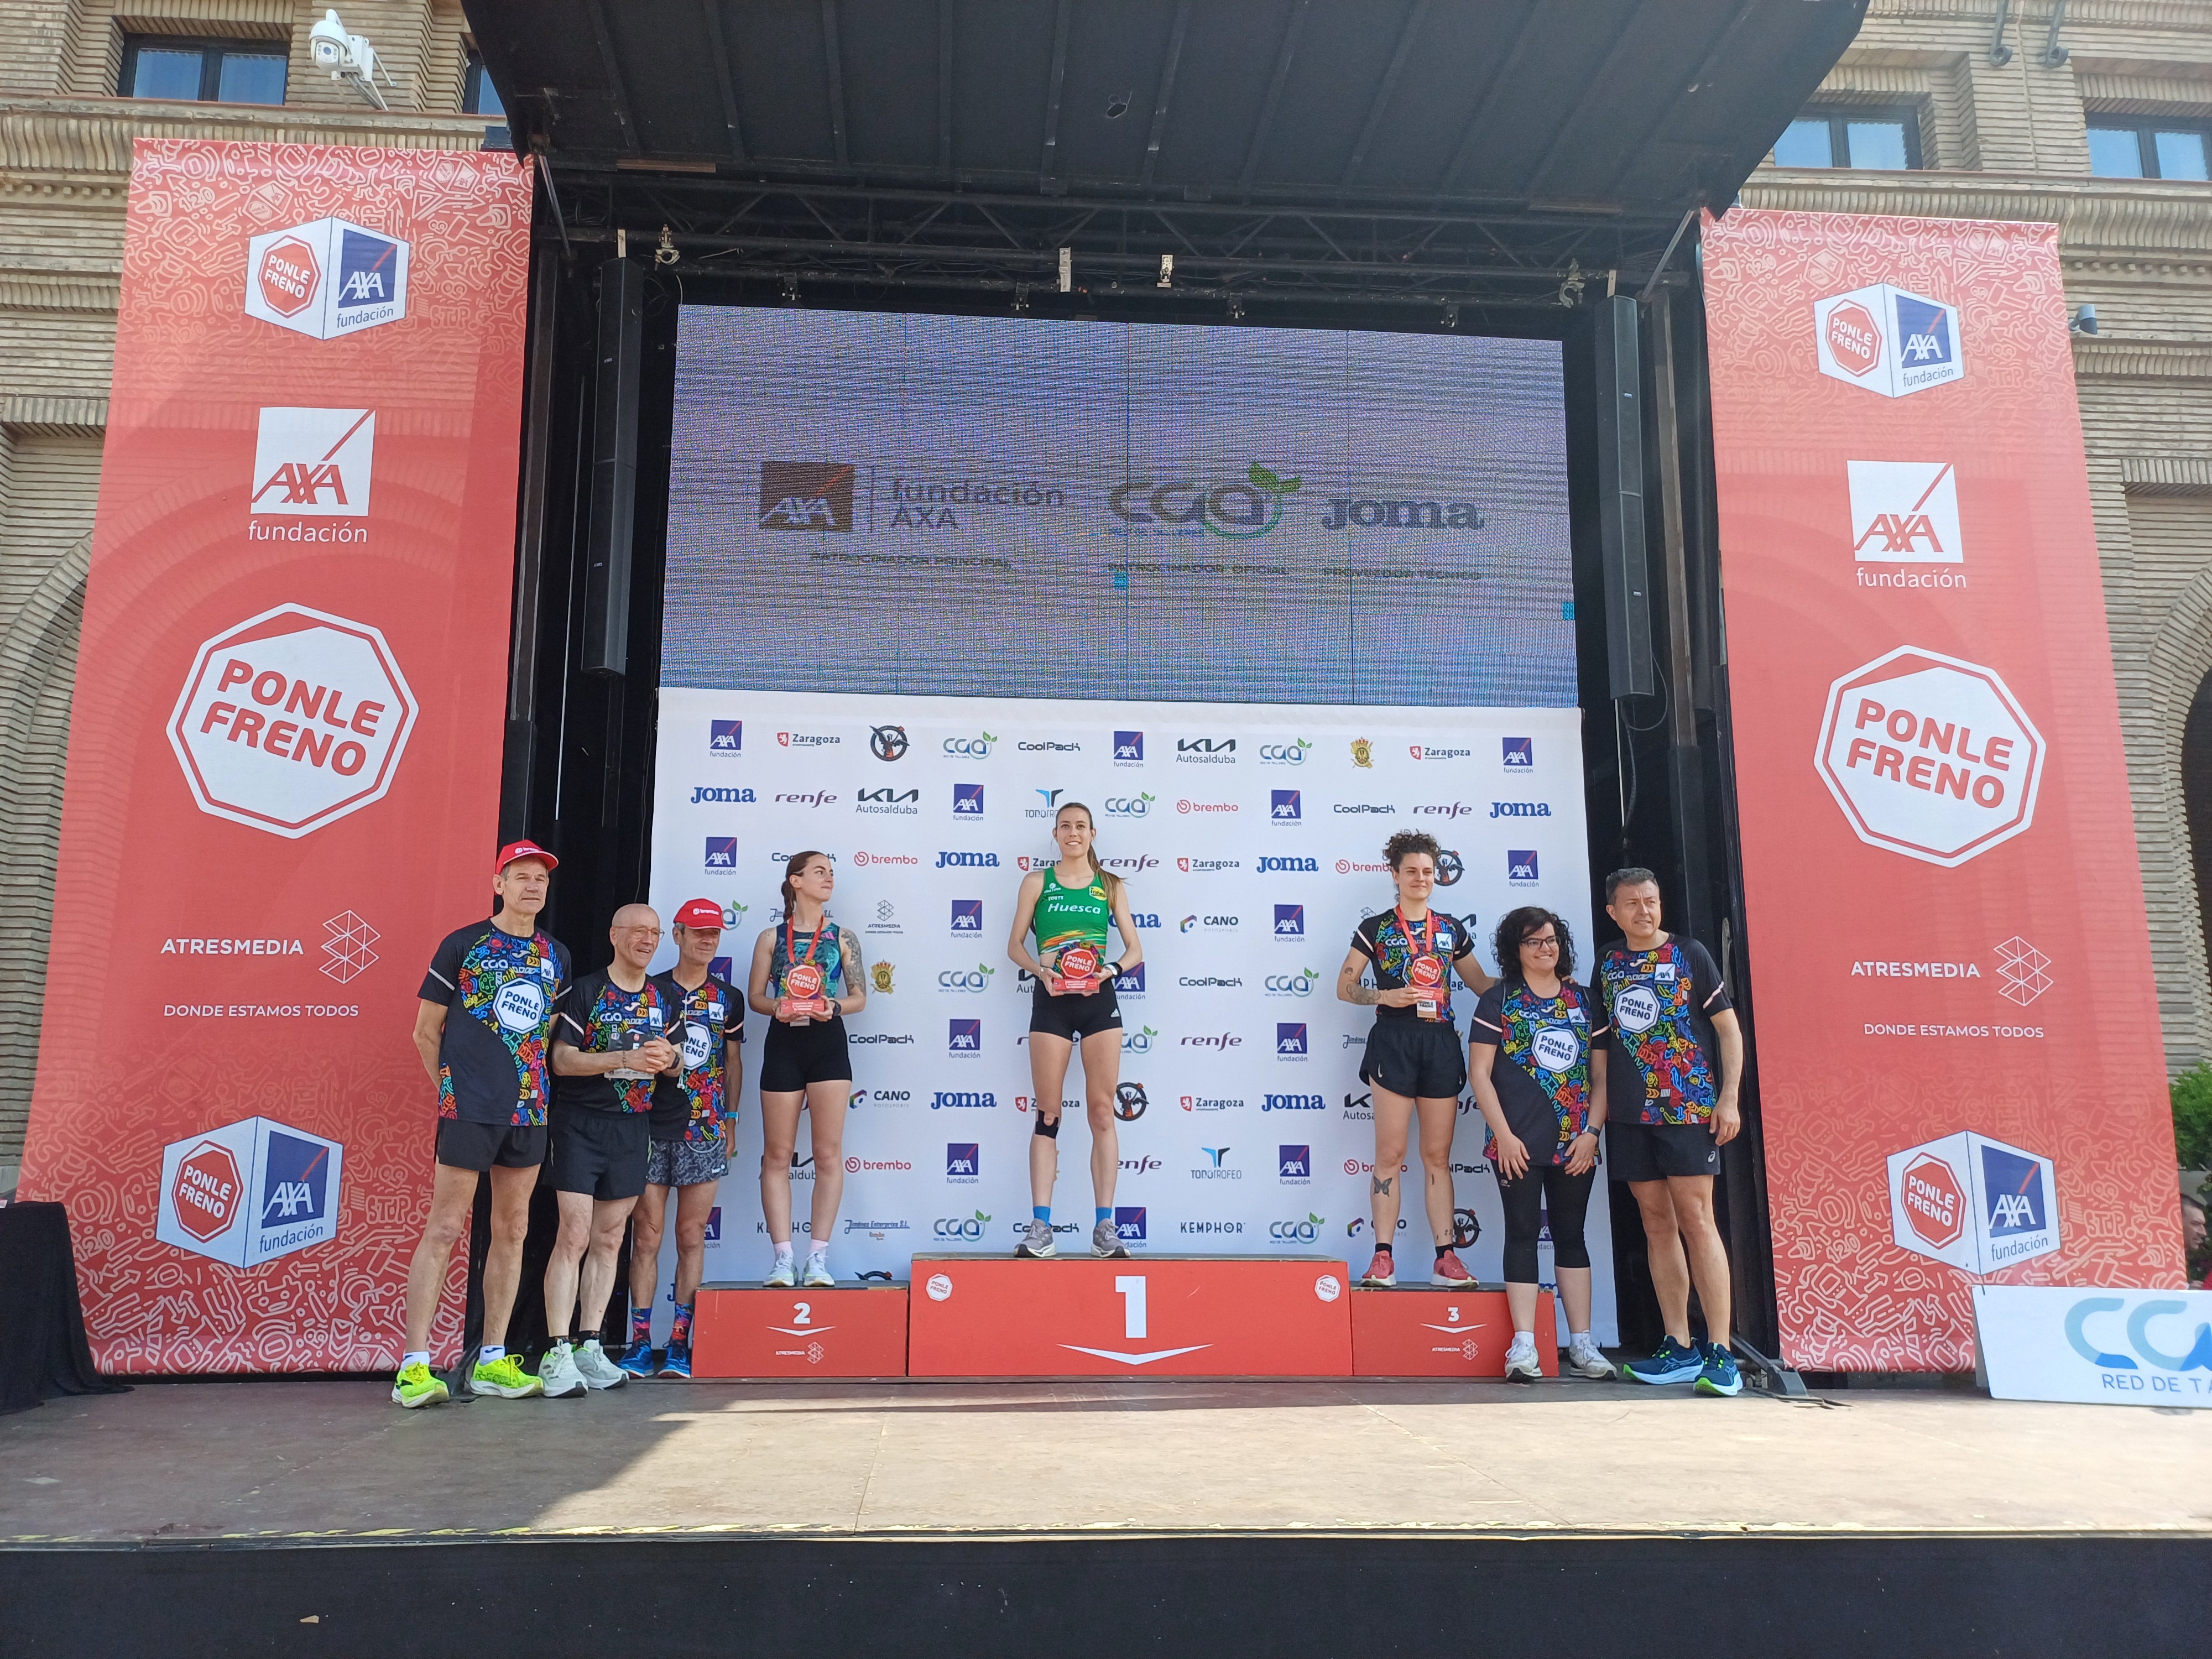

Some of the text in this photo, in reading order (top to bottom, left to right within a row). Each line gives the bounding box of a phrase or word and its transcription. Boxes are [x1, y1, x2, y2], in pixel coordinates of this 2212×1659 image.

[268, 254, 310, 283] PONLE
[265, 270, 306, 299] FRENO
[339, 270, 384, 300] AXA
[336, 306, 394, 328] fundación
[1833, 317, 1872, 346] PONLE
[1831, 333, 1870, 359] FRENO
[1901, 334, 1943, 362] AXA
[1903, 367, 1954, 387] fundación
[253, 463, 348, 505] AXA
[893, 479, 1063, 506] fundación
[758, 496, 836, 525] AXA
[891, 508, 958, 529] AXA
[248, 521, 368, 543] fundación
[1854, 514, 1944, 552] AXA
[1856, 568, 1966, 588] fundación
[217, 659, 385, 737] PONLE
[200, 702, 366, 775] FRENO
[792, 734, 839, 745] Zaragoza
[1855, 698, 2013, 771] PONLE
[711, 735, 736, 750] AXA
[1018, 742, 1080, 751] CoolPack
[1114, 745, 1138, 759] AXA
[1176, 754, 1235, 763] Autosalduba
[1425, 748, 1470, 759] Zaragoza
[1503, 751, 1527, 764] AXA
[1846, 738, 2004, 808] FRENO
[775, 790, 837, 808] renfe
[953, 799, 978, 813] AXA
[855, 805, 917, 814] Autosalduba
[1193, 802, 1238, 812] brembo
[1271, 804, 1296, 817] AXA
[1334, 805, 1395, 813] CoolPack
[1413, 801, 1472, 820] renfe
[706, 852, 730, 867] AXA
[872, 854, 917, 864] brembo
[1099, 854, 1159, 872] renfe
[1193, 859, 1239, 871] Zaragoza
[1353, 862, 1391, 872] bremb
[1509, 865, 1532, 878] AXA
[1048, 902, 1100, 914] Huesca
[951, 915, 976, 928] AXA
[1204, 916, 1238, 925] CANO
[1275, 919, 1300, 933] AXA
[160, 939, 303, 954] ATRESMEDIA
[1065, 962, 1090, 972] FRENO
[1067, 956, 1092, 966] PONLE
[1417, 962, 1438, 974] PONLE
[1415, 969, 1436, 979] FRENO
[1851, 962, 1980, 977] ATRESMEDIA
[791, 979, 815, 990] FRENO
[792, 973, 817, 984] PONLE
[1115, 975, 1139, 989] AXA
[1180, 977, 1242, 987] CoolPack
[505, 990, 539, 1011] PONLE
[1621, 997, 1652, 1011] PONLE
[164, 1005, 358, 1016] DONDE ESTAMOS TODOS
[501, 1001, 537, 1020] FRENO
[1619, 1005, 1651, 1020] FRENO
[1865, 1024, 2043, 1037] DONDE ESTAMOS TODOS
[849, 1034, 914, 1044] CoolPack
[950, 1036, 975, 1049] AXA
[1181, 1032, 1241, 1051] renfe
[1277, 1039, 1300, 1051] AXA
[1541, 1035, 1573, 1053] PONLE
[1539, 1044, 1571, 1061] FRENO
[874, 1091, 910, 1100] CANO
[1196, 1098, 1244, 1110] Zaragoza
[864, 1160, 911, 1170] brembo
[948, 1159, 973, 1173] AXA
[1118, 1155, 1162, 1175] enfe
[1280, 1161, 1305, 1175] AXA
[1191, 1170, 1241, 1179] TODOTROFEO
[183, 1165, 232, 1200] PONLE
[262, 1182, 314, 1218] AXA
[1908, 1175, 1954, 1210] PONLE
[179, 1186, 226, 1218] FRENO
[1908, 1193, 1952, 1227] FRENO
[1991, 1194, 2036, 1228] AXA
[1116, 1224, 1140, 1237] AXA
[1180, 1222, 1243, 1233] KEMPHOR
[259, 1223, 323, 1253] fundación
[1991, 1234, 2048, 1261] fundación
[794, 1303, 810, 1324] 2
[1115, 1276, 1146, 1338] 1
[1448, 1307, 1459, 1321] 3
[2102, 1374, 2182, 1392] RED DE
